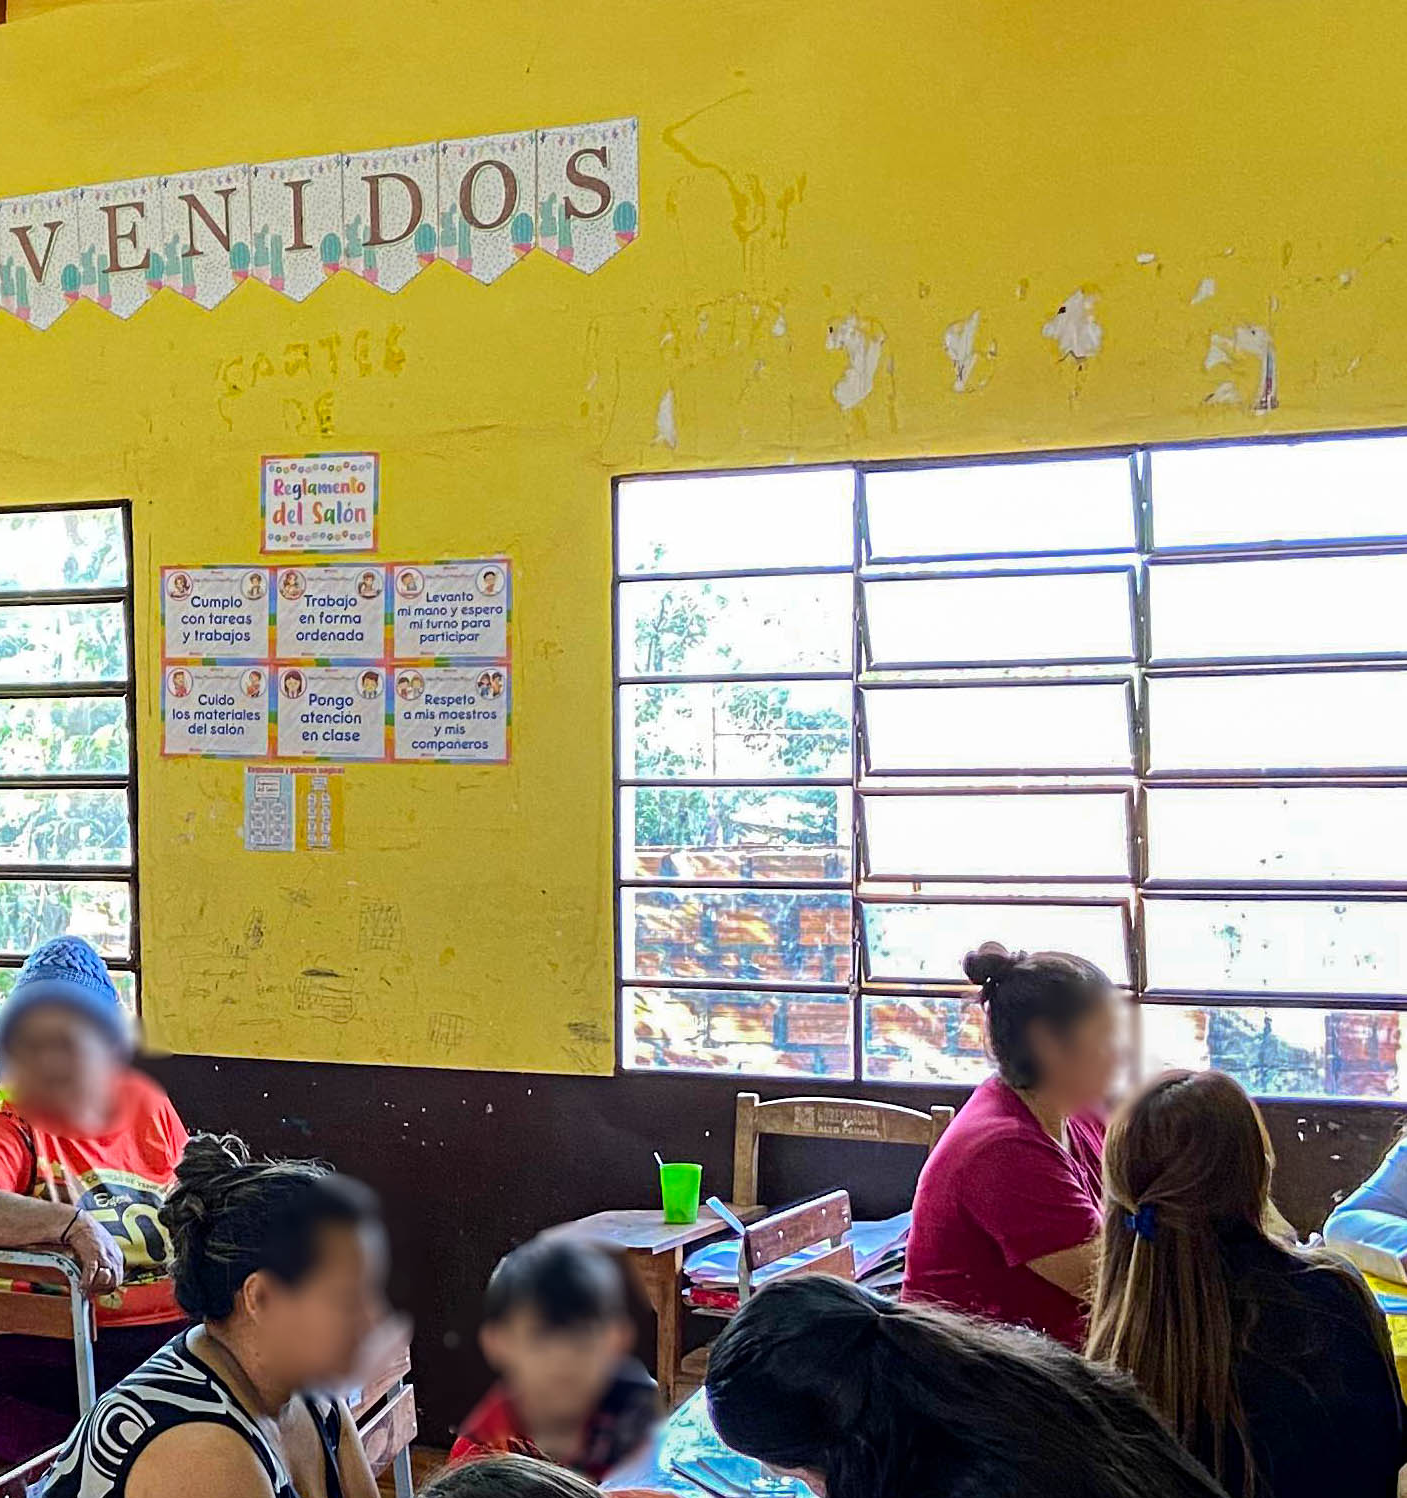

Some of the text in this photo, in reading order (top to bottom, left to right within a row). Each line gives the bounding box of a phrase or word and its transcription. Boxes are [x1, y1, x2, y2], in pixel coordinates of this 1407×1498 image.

[273, 476, 366, 501] Reglamento
[272, 500, 367, 526] del Salón
[190, 595, 243, 610] Cumplo
[303, 594, 358, 611] Trabajo
[426, 592, 474, 603] Levanto
[299, 611, 362, 624] en forma
[397, 605, 503, 617] mi mano y espero
[181, 612, 252, 625] con tareas
[409, 619, 491, 630] mi turno para
[182, 629, 251, 645] y trabajos
[296, 629, 364, 641] ordenada
[419, 631, 480, 645] participar
[198, 694, 235, 706] Cuido
[308, 693, 354, 710] Pongo
[424, 694, 476, 707] Respeto
[172, 709, 261, 720] los materiales
[403, 709, 497, 720] a mis maestros
[188, 723, 207, 735] del
[302, 729, 361, 741] en clase
[433, 724, 466, 737] y mis
